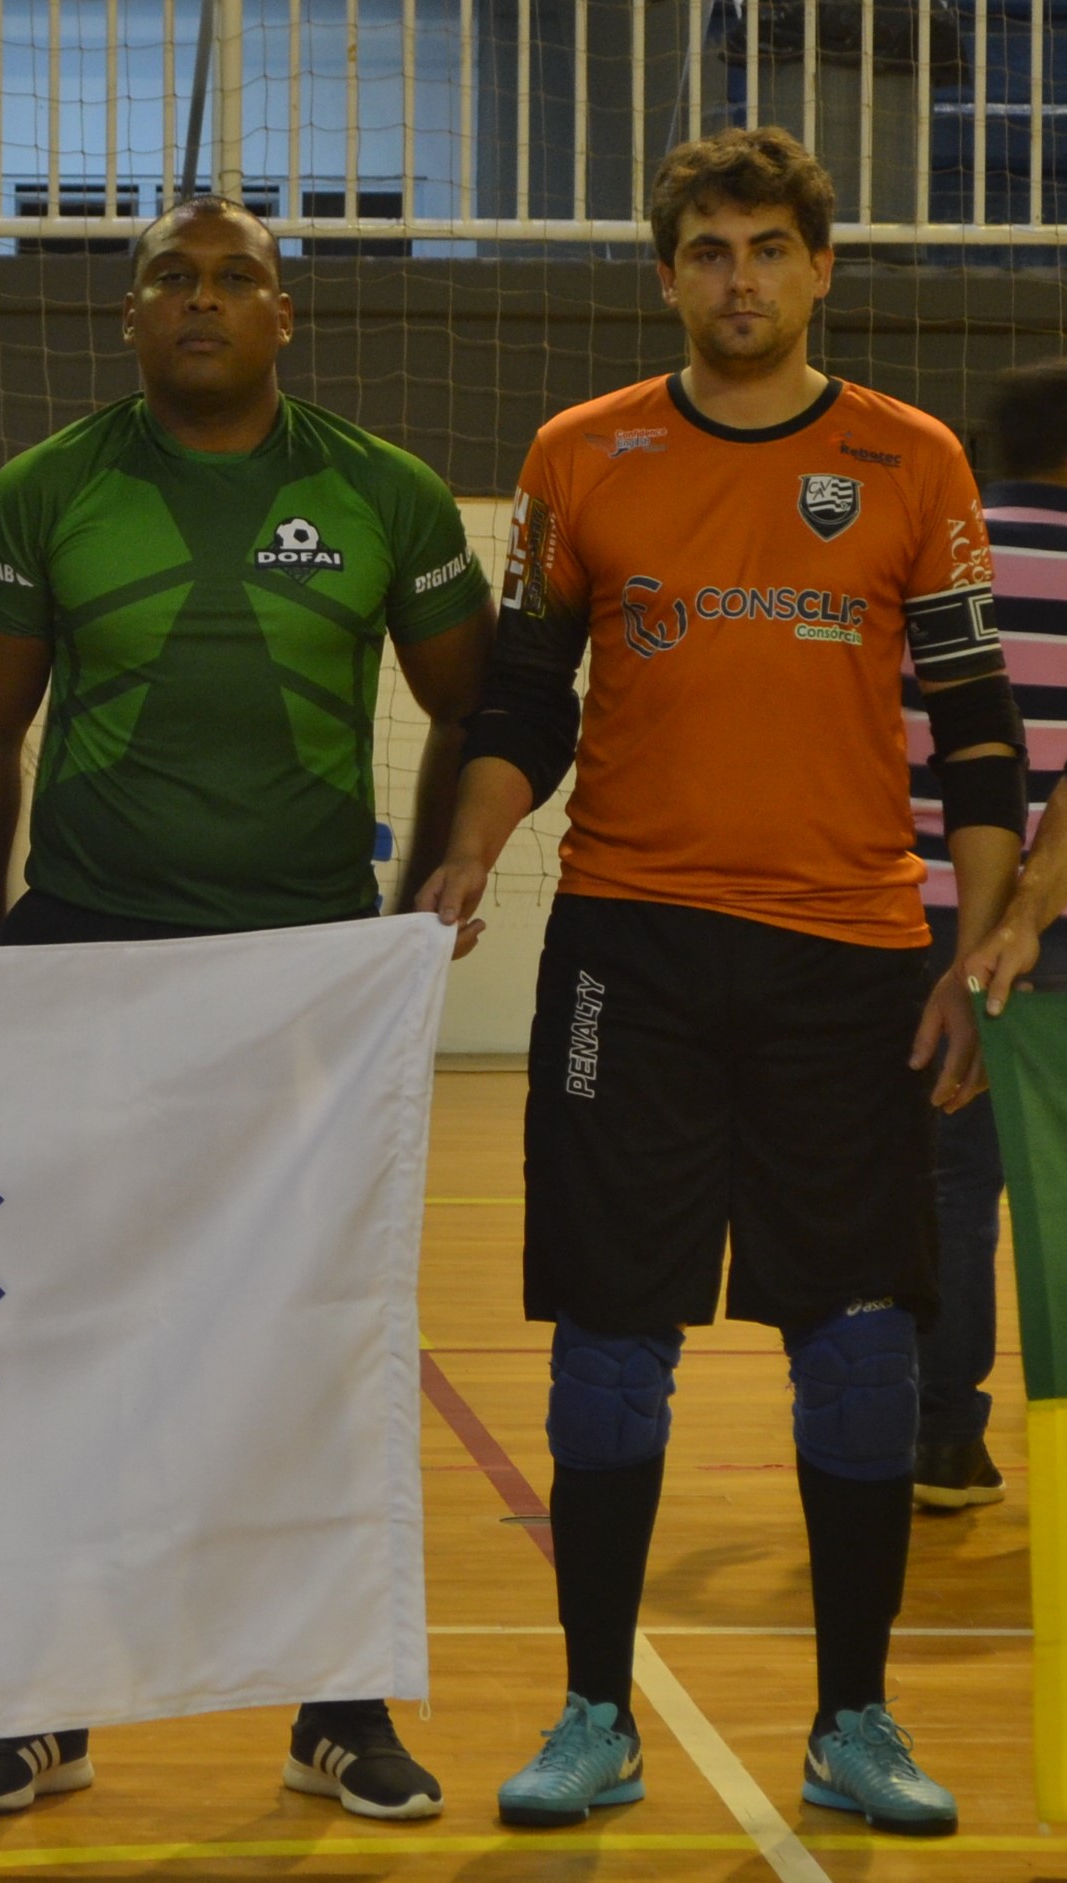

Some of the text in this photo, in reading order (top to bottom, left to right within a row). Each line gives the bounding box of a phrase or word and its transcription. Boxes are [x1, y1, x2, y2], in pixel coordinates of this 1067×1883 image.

[257, 551, 341, 565] DOFAI
[414, 552, 467, 594] DIGITAL
[566, 969, 606, 1099] PENALTY
